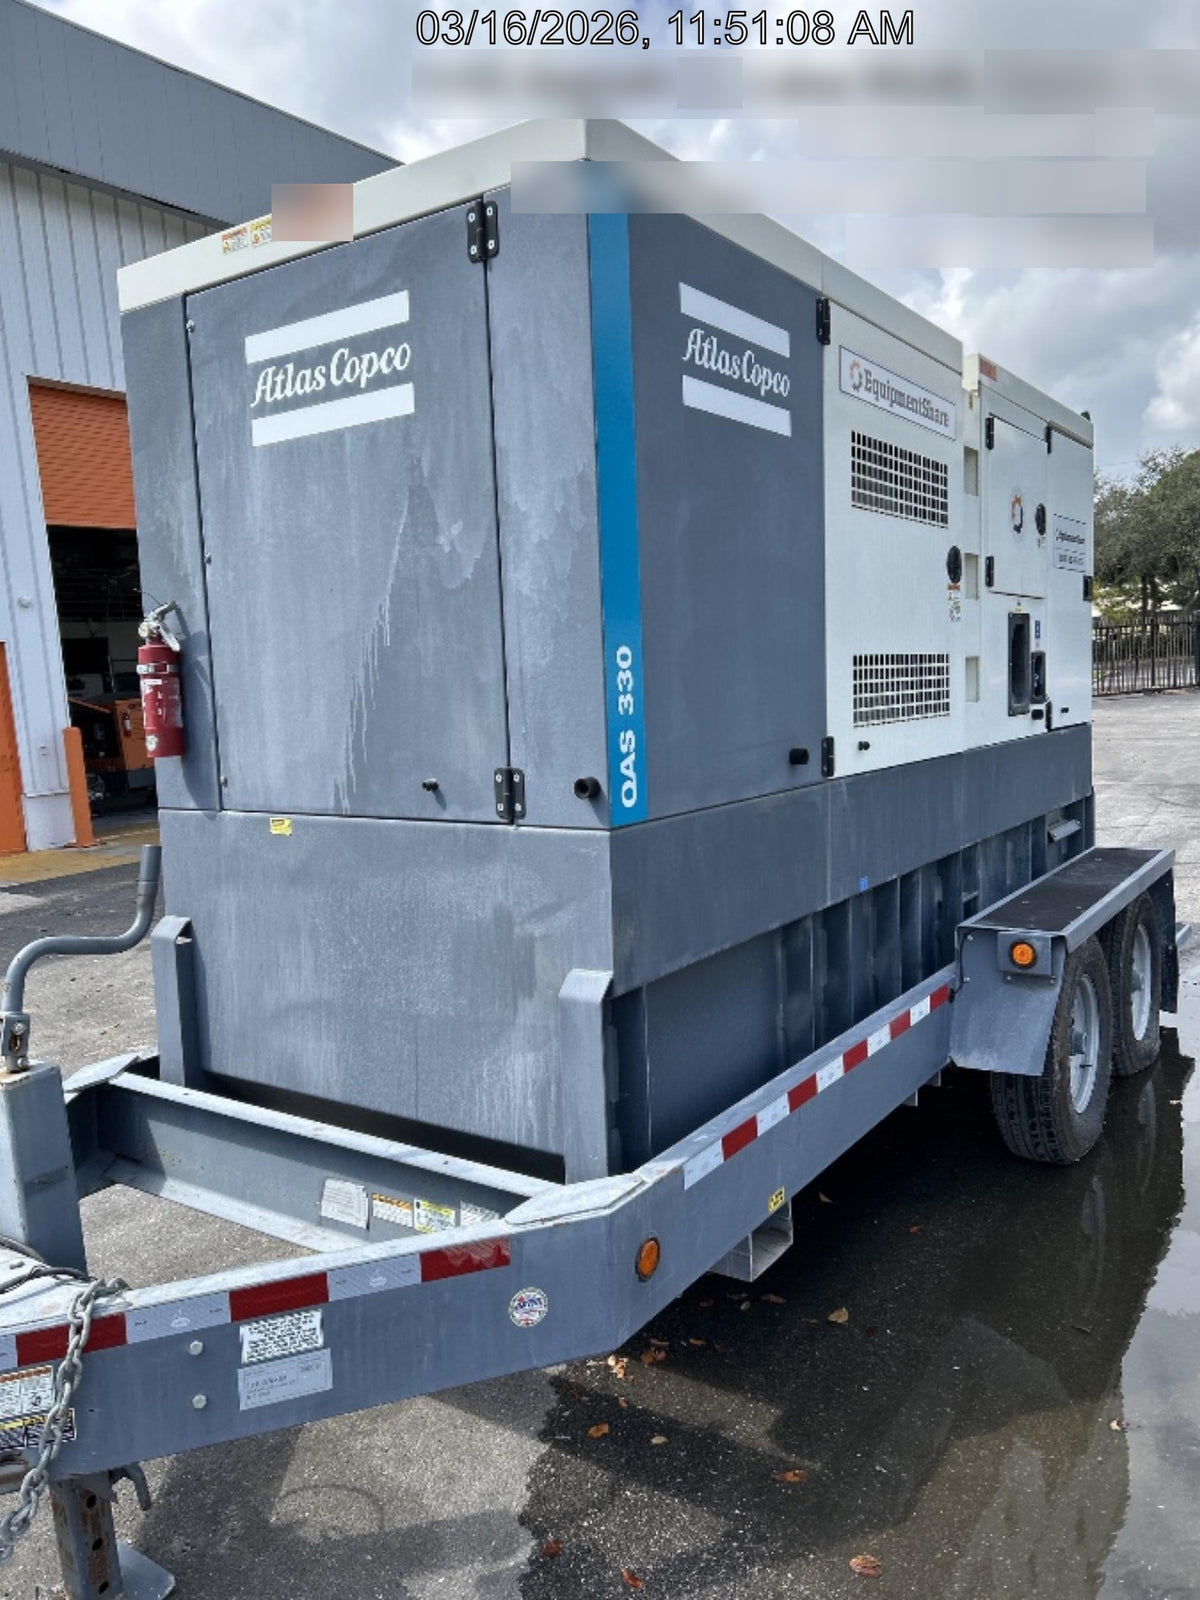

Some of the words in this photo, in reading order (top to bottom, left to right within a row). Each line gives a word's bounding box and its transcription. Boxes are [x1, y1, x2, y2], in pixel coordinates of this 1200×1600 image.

[250, 362, 327, 408] Atlas
[330, 342, 412, 388] Copco
[682, 328, 740, 379] Atlas
[742, 350, 790, 397] Copco
[864, 368, 949, 427] EquipmentShare
[616, 645, 634, 716] 330
[620, 729, 637, 808] QAS
